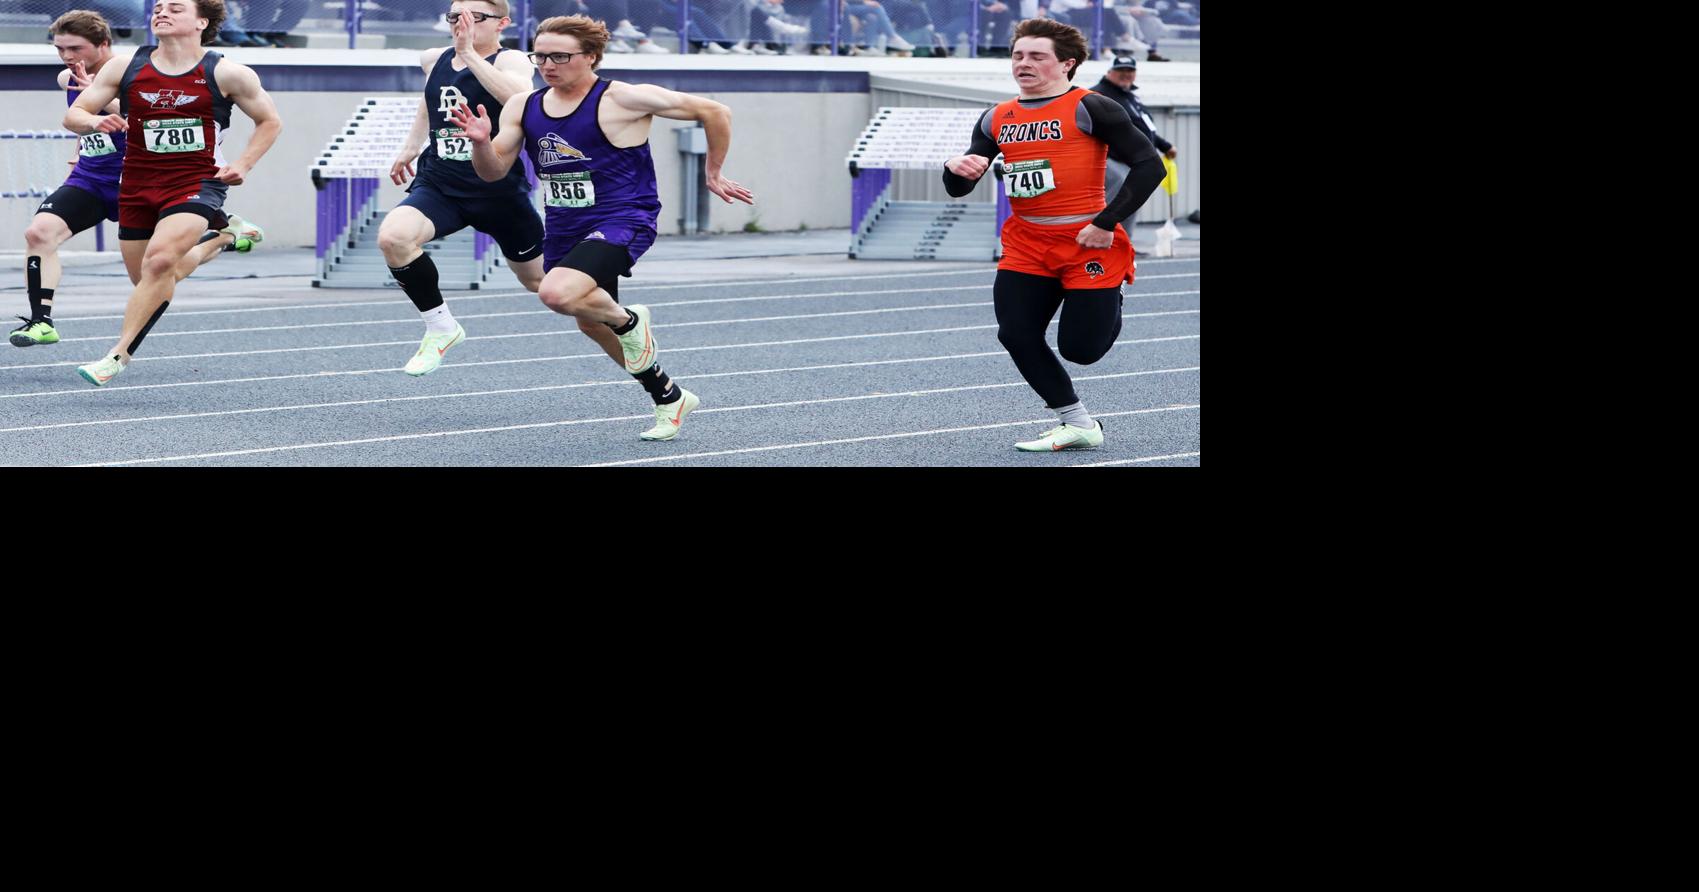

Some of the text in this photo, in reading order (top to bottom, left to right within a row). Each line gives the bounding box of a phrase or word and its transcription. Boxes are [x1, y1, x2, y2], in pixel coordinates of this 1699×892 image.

[153, 128, 195, 146] 780
[997, 119, 1062, 145] BRONCS
[80, 134, 105, 150] 46
[444, 138, 472, 154] 52
[351, 168, 379, 177] BUTTE
[550, 181, 586, 200] 856
[1009, 171, 1044, 193] 740
